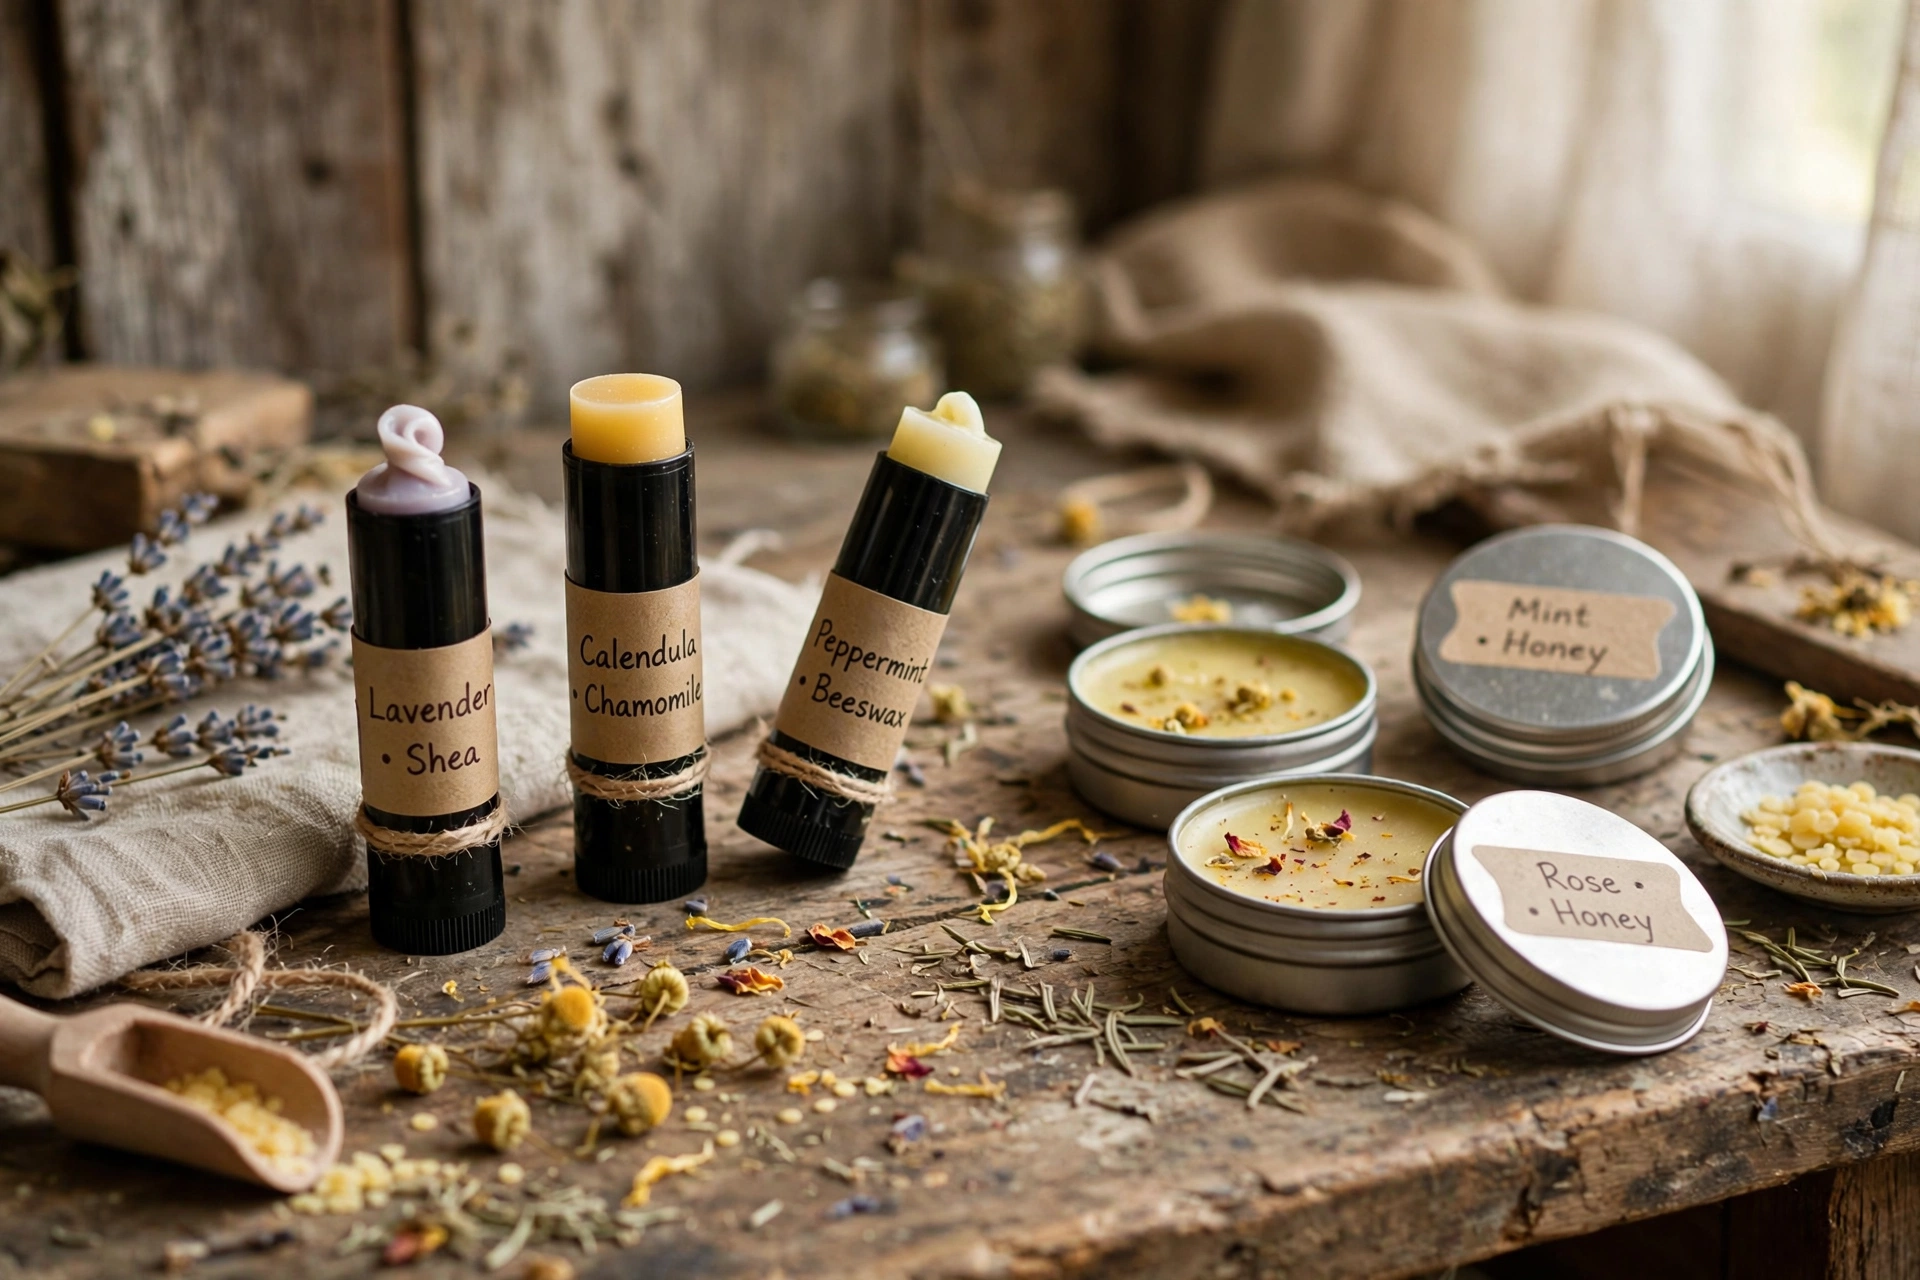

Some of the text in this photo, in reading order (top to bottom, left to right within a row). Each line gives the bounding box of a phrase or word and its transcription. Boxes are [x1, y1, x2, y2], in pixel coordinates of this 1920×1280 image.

[1508, 597, 1592, 627] Mint
[580, 628, 697, 670] Calendula
[814, 618, 929, 684] Peppermint
[1503, 630, 1609, 676] Honey
[369, 681, 491, 724] Lavender
[584, 673, 702, 718] Chamomile
[811, 673, 907, 728] Beeswax
[406, 742, 481, 776] Shea
[1536, 861, 1622, 894] Rose
[1549, 898, 1655, 943] Honey
